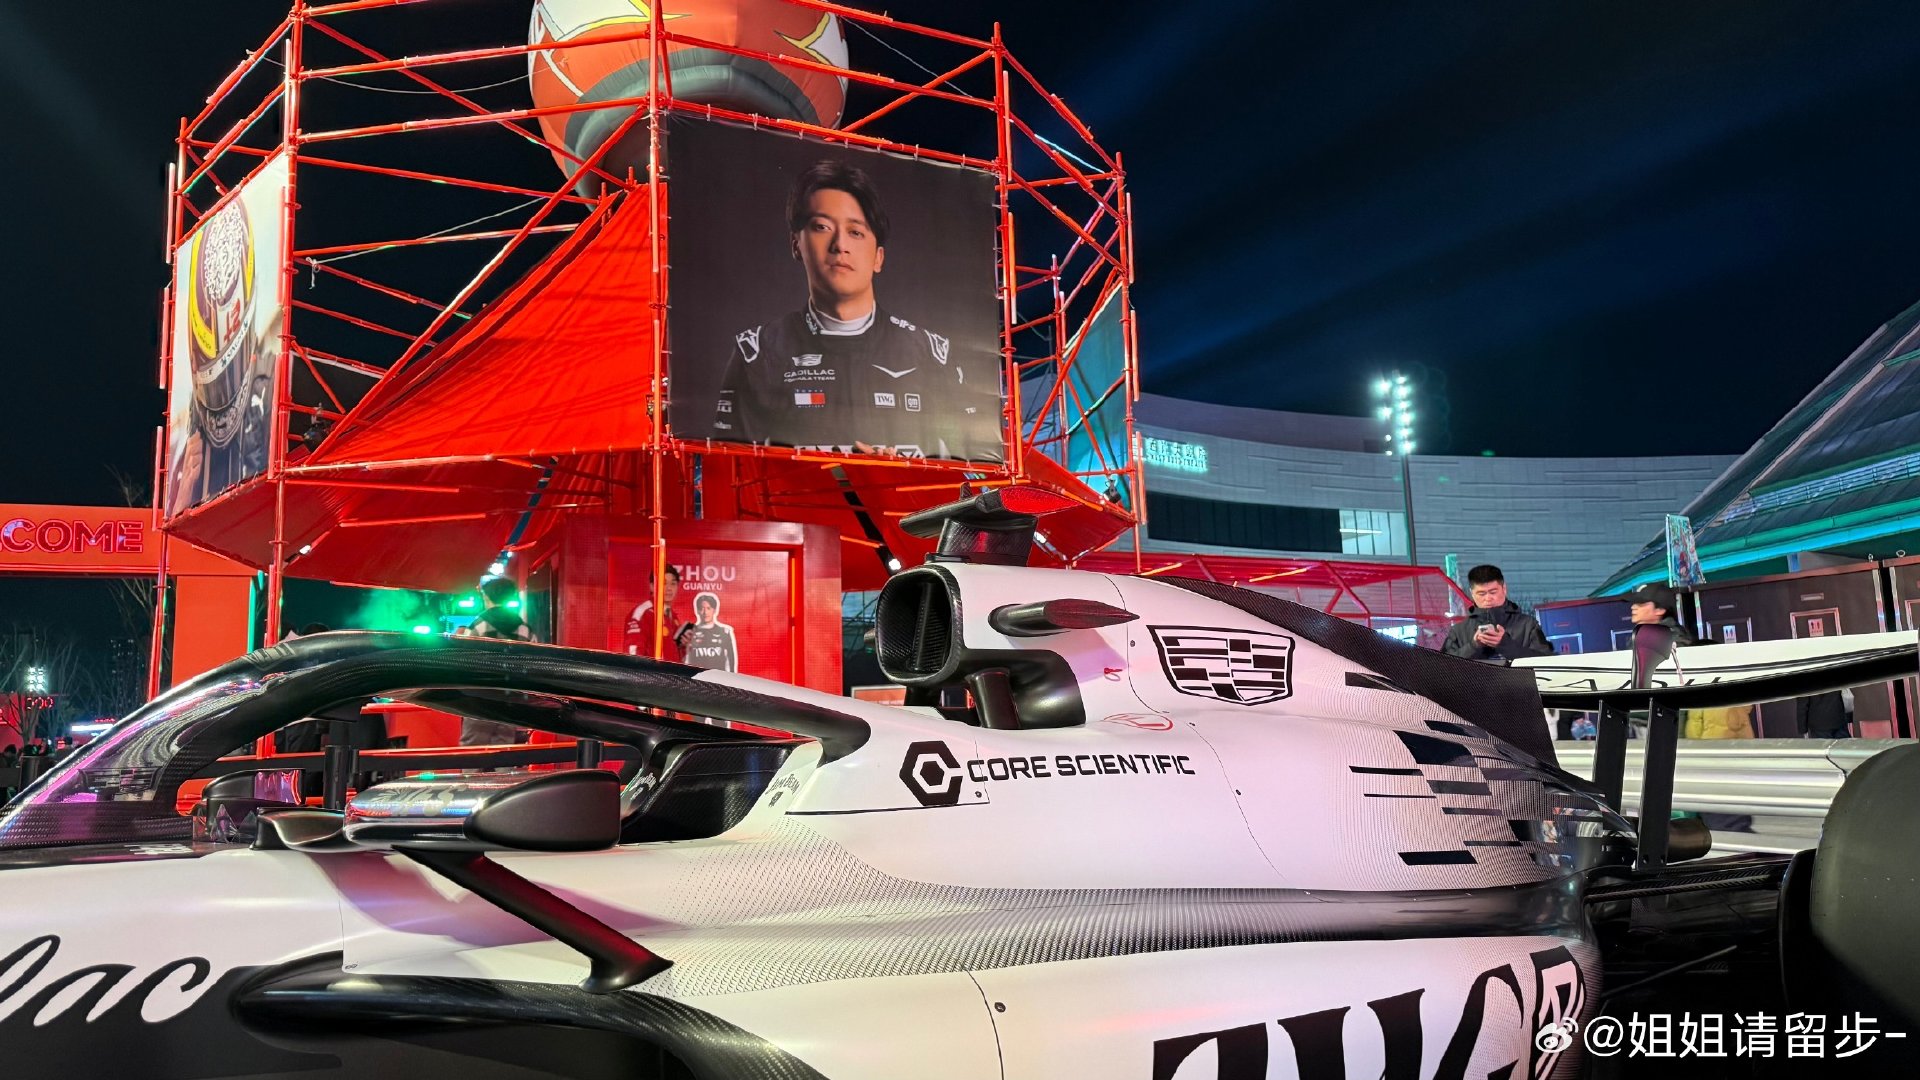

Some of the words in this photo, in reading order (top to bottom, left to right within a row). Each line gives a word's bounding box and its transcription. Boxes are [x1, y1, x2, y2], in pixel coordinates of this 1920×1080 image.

[784, 369, 836, 378] CADILLAC
[0, 518, 144, 553] COME
[683, 582, 723, 591] GUANYU
[967, 756, 1051, 782] CORE
[1056, 754, 1196, 777] SCIENTIFIC
